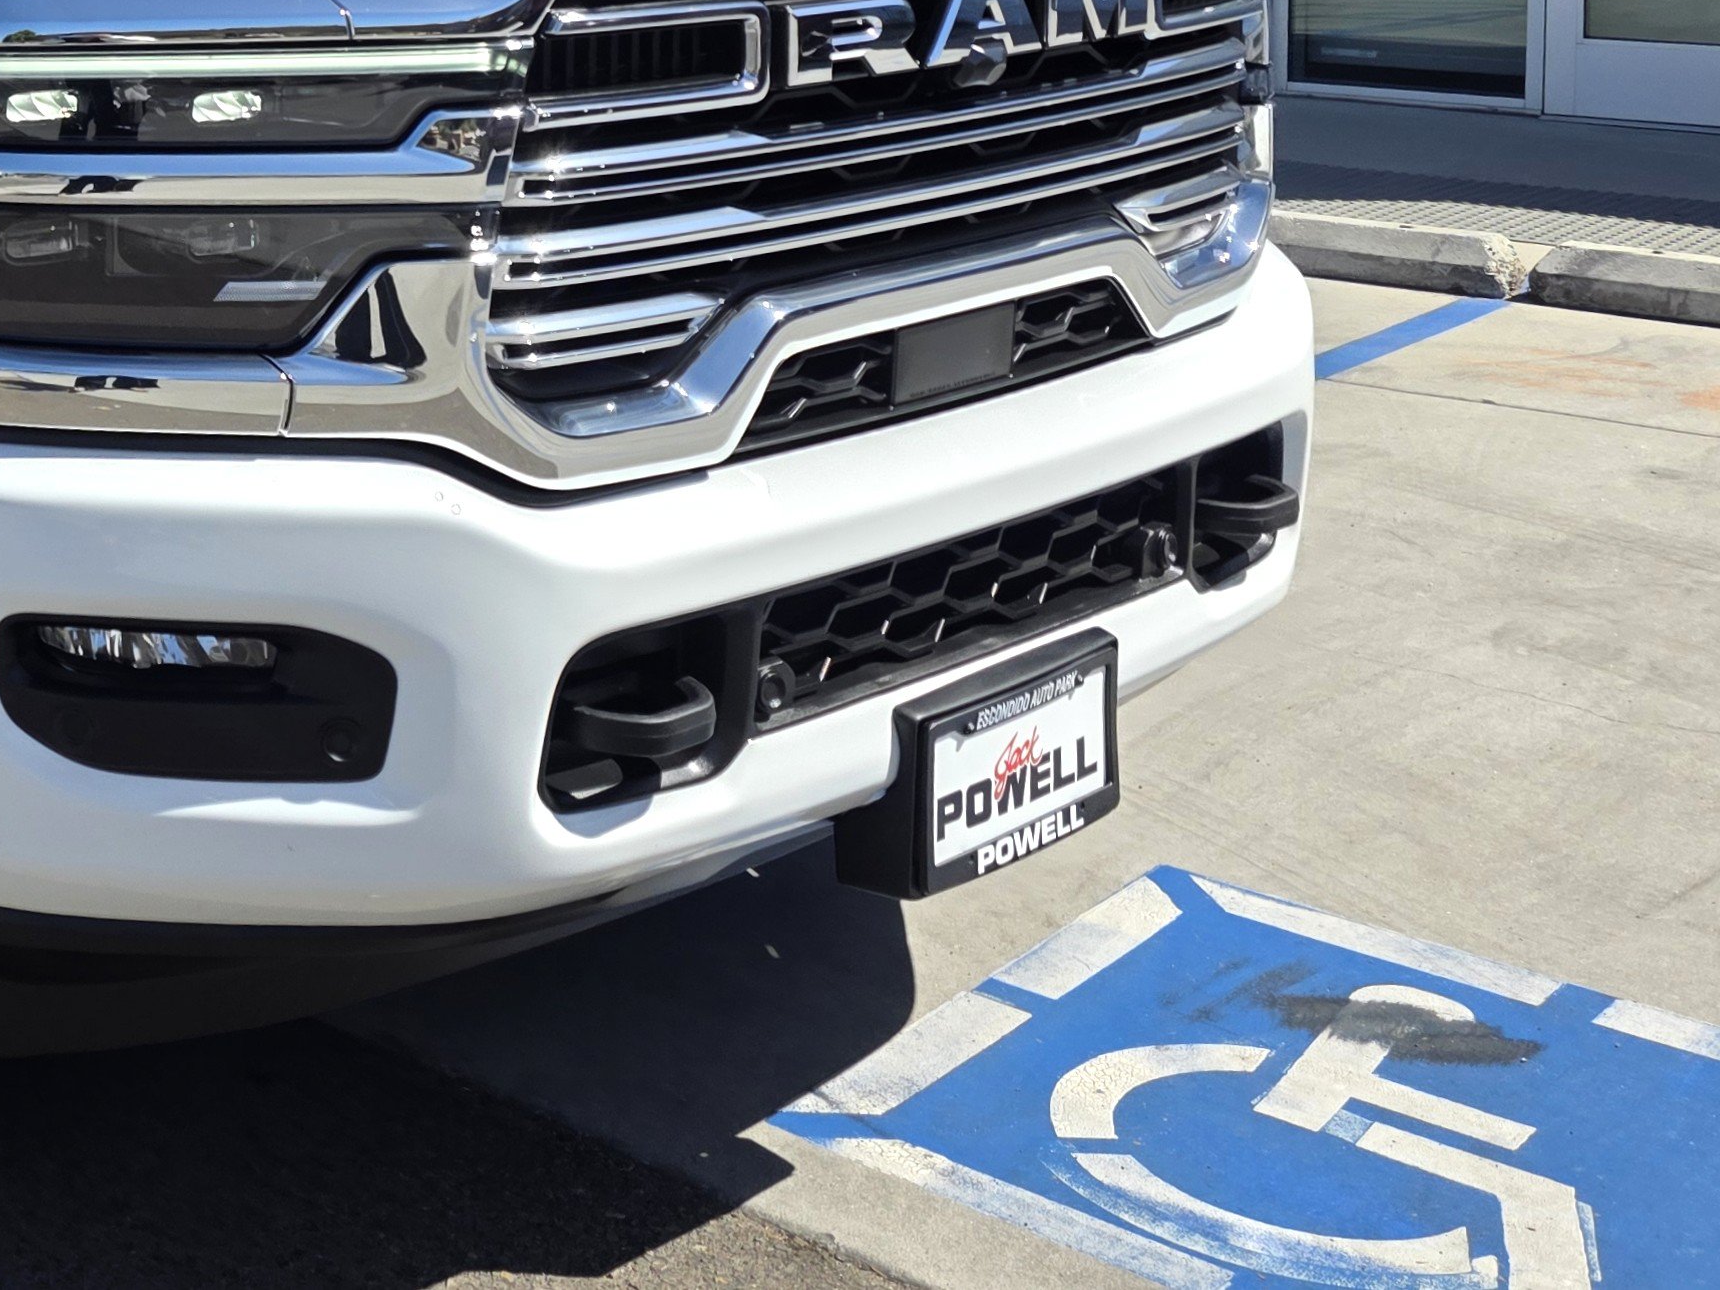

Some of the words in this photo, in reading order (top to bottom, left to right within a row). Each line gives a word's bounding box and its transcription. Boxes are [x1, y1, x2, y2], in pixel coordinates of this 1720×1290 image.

[976, 691, 1031, 731] ESCONDIDO
[1029, 681, 1055, 709] AUTO
[1053, 670, 1078, 698] PARK
[936, 736, 1098, 843] POWELL
[994, 725, 1044, 801] Jack
[977, 804, 1085, 875] POWELL
